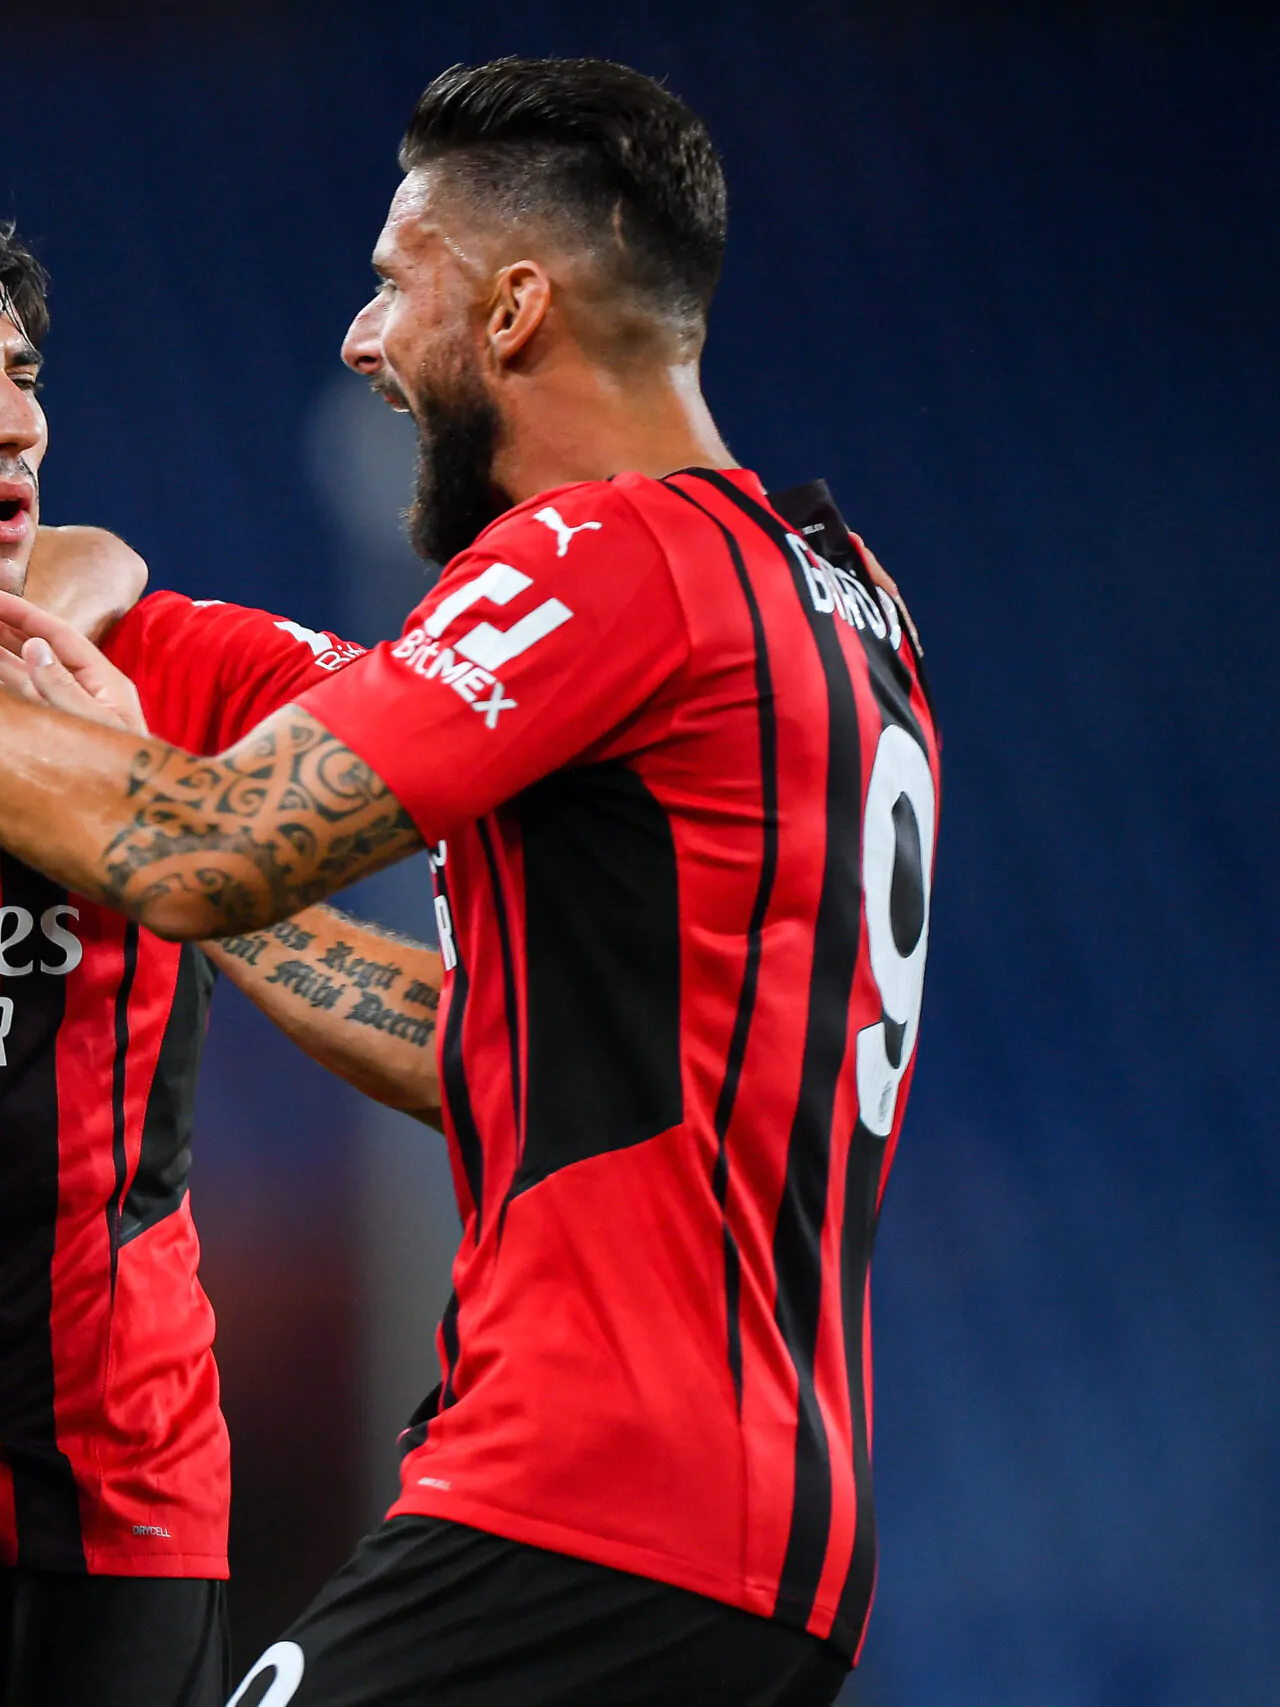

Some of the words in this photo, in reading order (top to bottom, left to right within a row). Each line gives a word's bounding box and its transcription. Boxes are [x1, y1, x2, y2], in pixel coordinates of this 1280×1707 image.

[391, 628, 518, 730] BitMEX
[856, 723, 936, 1137] 9
[132, 1525, 172, 1538] DRYCELL
